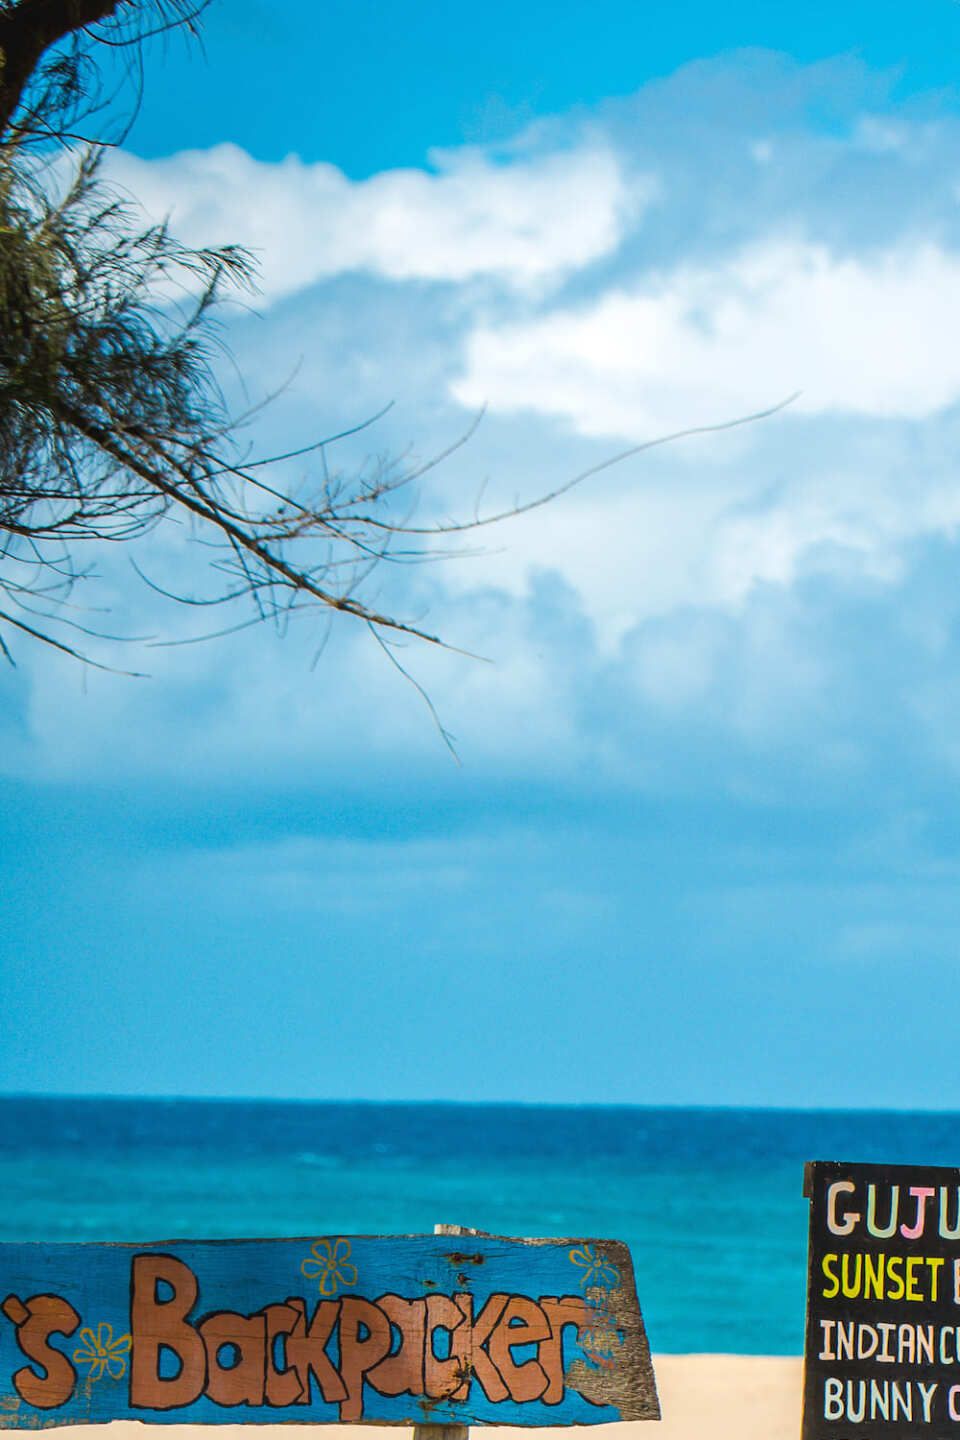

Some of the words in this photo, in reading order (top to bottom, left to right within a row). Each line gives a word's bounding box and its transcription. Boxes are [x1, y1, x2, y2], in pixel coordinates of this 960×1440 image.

[821, 1253, 944, 1302] SUNSET
[128, 1252, 620, 1421] Backpacker
[819, 1320, 934, 1364] INDIAN
[824, 1378, 938, 1423] BUNNY
